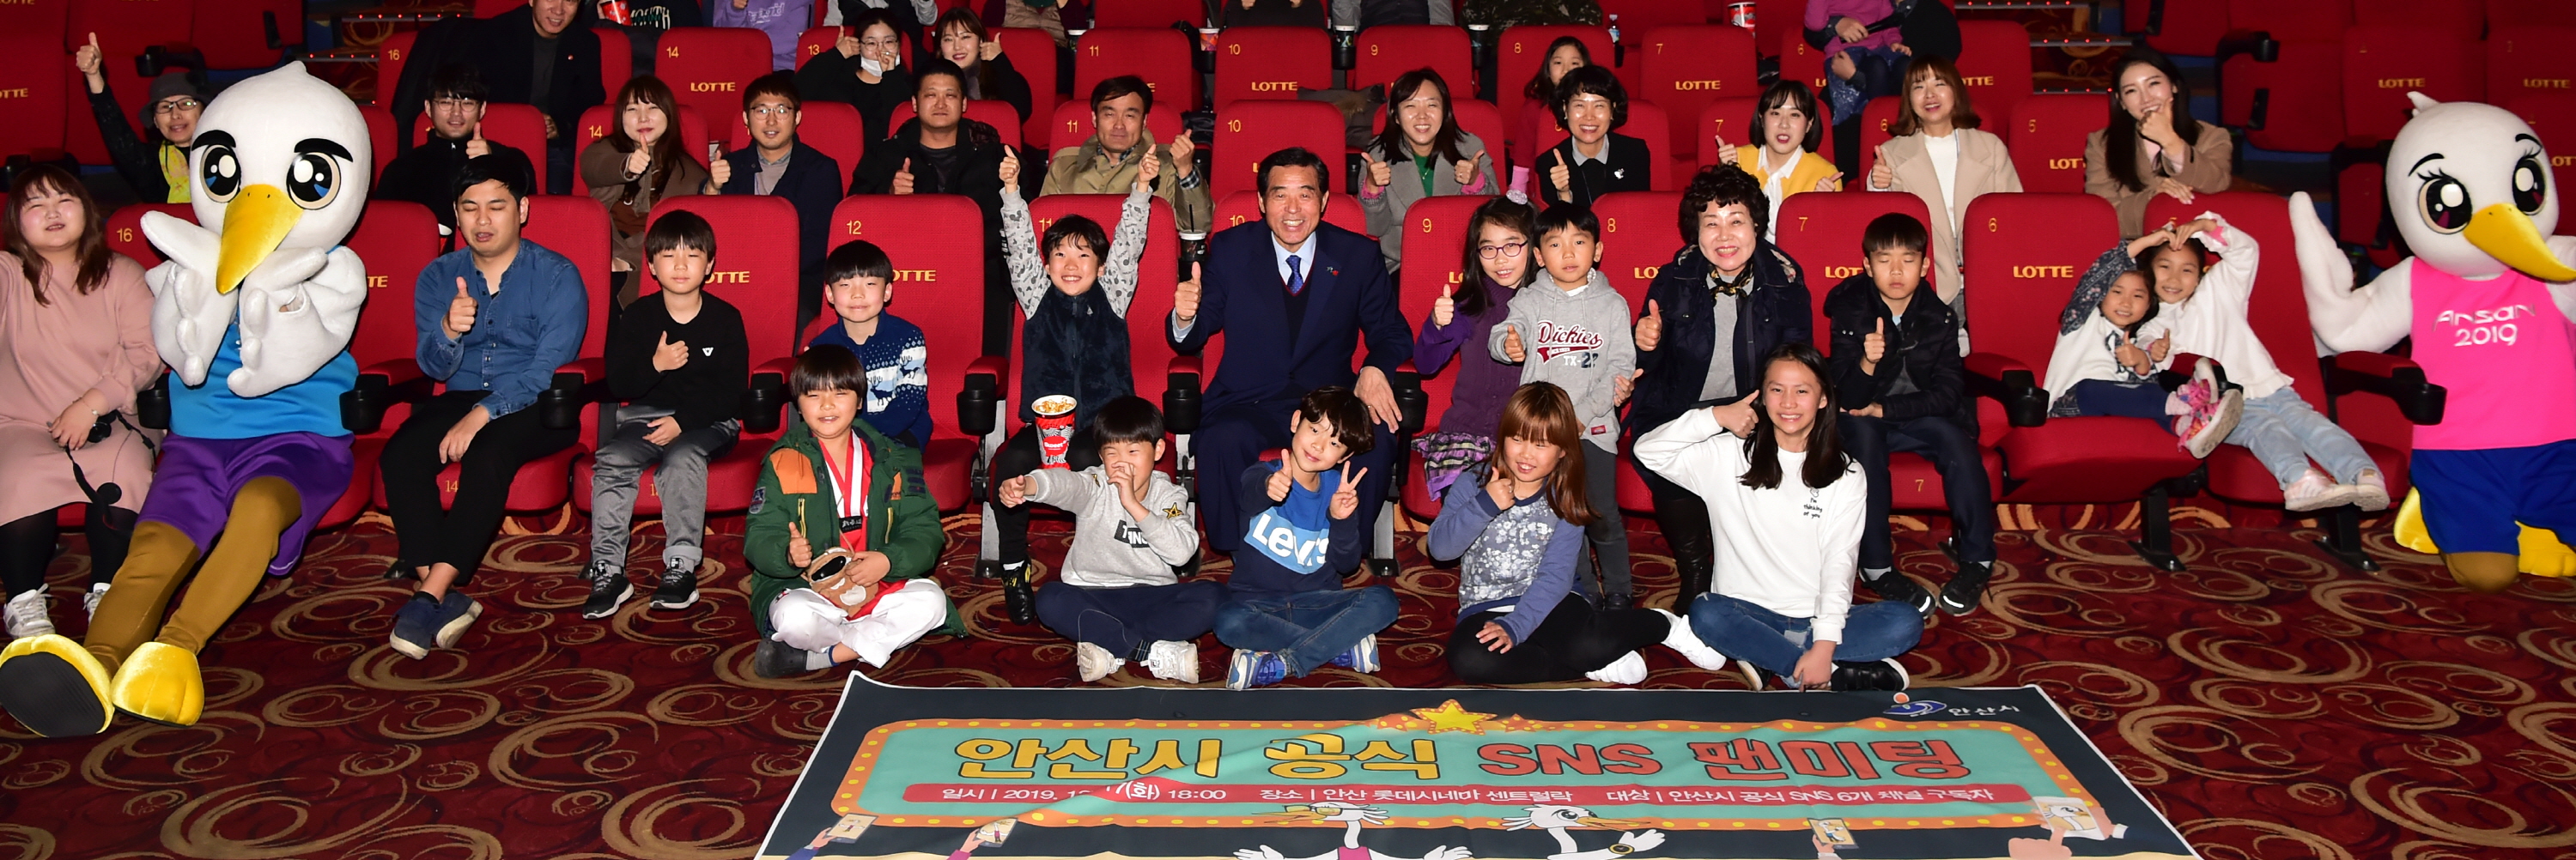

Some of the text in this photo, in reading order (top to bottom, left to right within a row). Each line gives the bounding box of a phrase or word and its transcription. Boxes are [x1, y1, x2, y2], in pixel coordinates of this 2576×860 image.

[388, 49, 400, 61] 16
[666, 45, 679, 58] 14
[807, 44, 820, 56] 13
[1089, 45, 1099, 57] 11
[1228, 43, 1241, 55] 10
[1370, 44, 1378, 56] 9
[1514, 42, 1522, 54] 8
[1656, 43, 1663, 54] 7
[690, 82, 736, 93] LOTTE
[1251, 81, 1297, 92] LOTTE
[1675, 80, 1721, 91] LOTTE
[2378, 78, 2423, 88] LOTTE
[2524, 78, 2569, 88] LOTTE
[588, 124, 603, 138] 14
[1066, 119, 1078, 133] 11
[1227, 119, 1242, 133] 10
[2050, 158, 2086, 170] LOT
[846, 220, 862, 235] 12
[1422, 218, 1432, 233] 9
[1607, 217, 1616, 233] 8
[1798, 216, 1808, 231] 7
[1989, 217, 1997, 233] 6
[116, 227, 133, 243] 16
[705, 270, 750, 284] OTTE
[892, 269, 938, 282] OTTE
[2013, 265, 2074, 279] LOTTE
[1537, 320, 1603, 349] Dickies
[2454, 324, 2518, 347] 2019
[445, 479, 459, 494] 14
[1915, 478, 1924, 492] 7
[1947, 705, 2021, 718] 안산시
[954, 732, 1971, 782] 안산시 공식 SNS 팬미팅
[942, 788, 985, 800] 일시
[1168, 790, 1227, 800] 18:00
[1259, 789, 1304, 801] 장소
[1322, 788, 1366, 802] 안산
[1371, 788, 1480, 802] 롯데시네마
[1606, 789, 1650, 802] 대상
[1668, 790, 1736, 803] 안산시
[1740, 790, 1786, 803] 공식
[1789, 790, 1834, 802] SNS
[1836, 790, 1874, 802] 6개
[1877, 789, 1924, 801] 채널
[1926, 788, 1994, 802] 구독자
